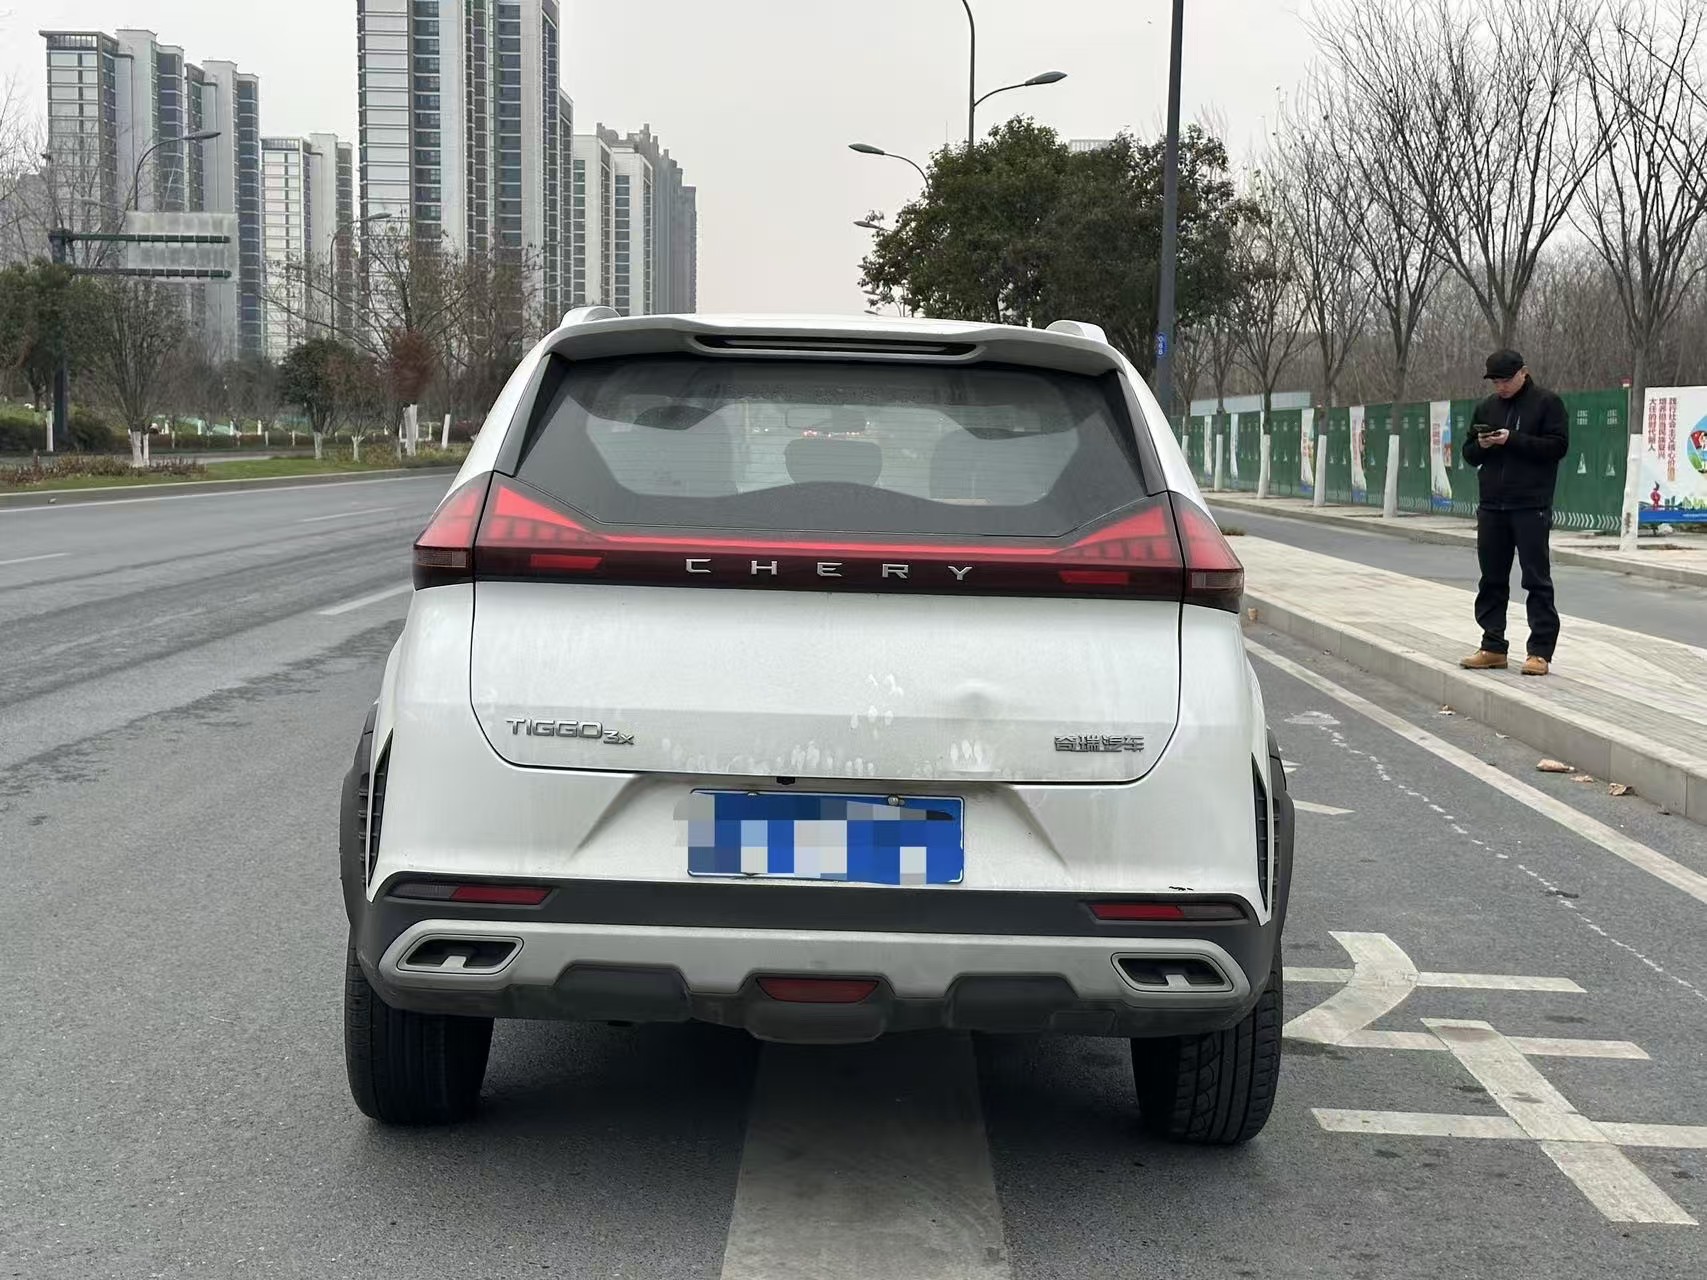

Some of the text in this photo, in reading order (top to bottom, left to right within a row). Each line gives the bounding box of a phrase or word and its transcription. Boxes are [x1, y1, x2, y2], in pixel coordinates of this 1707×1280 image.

[685, 558, 973, 581] CHERY
[1054, 734, 1145, 753] 奇瑞汽车
